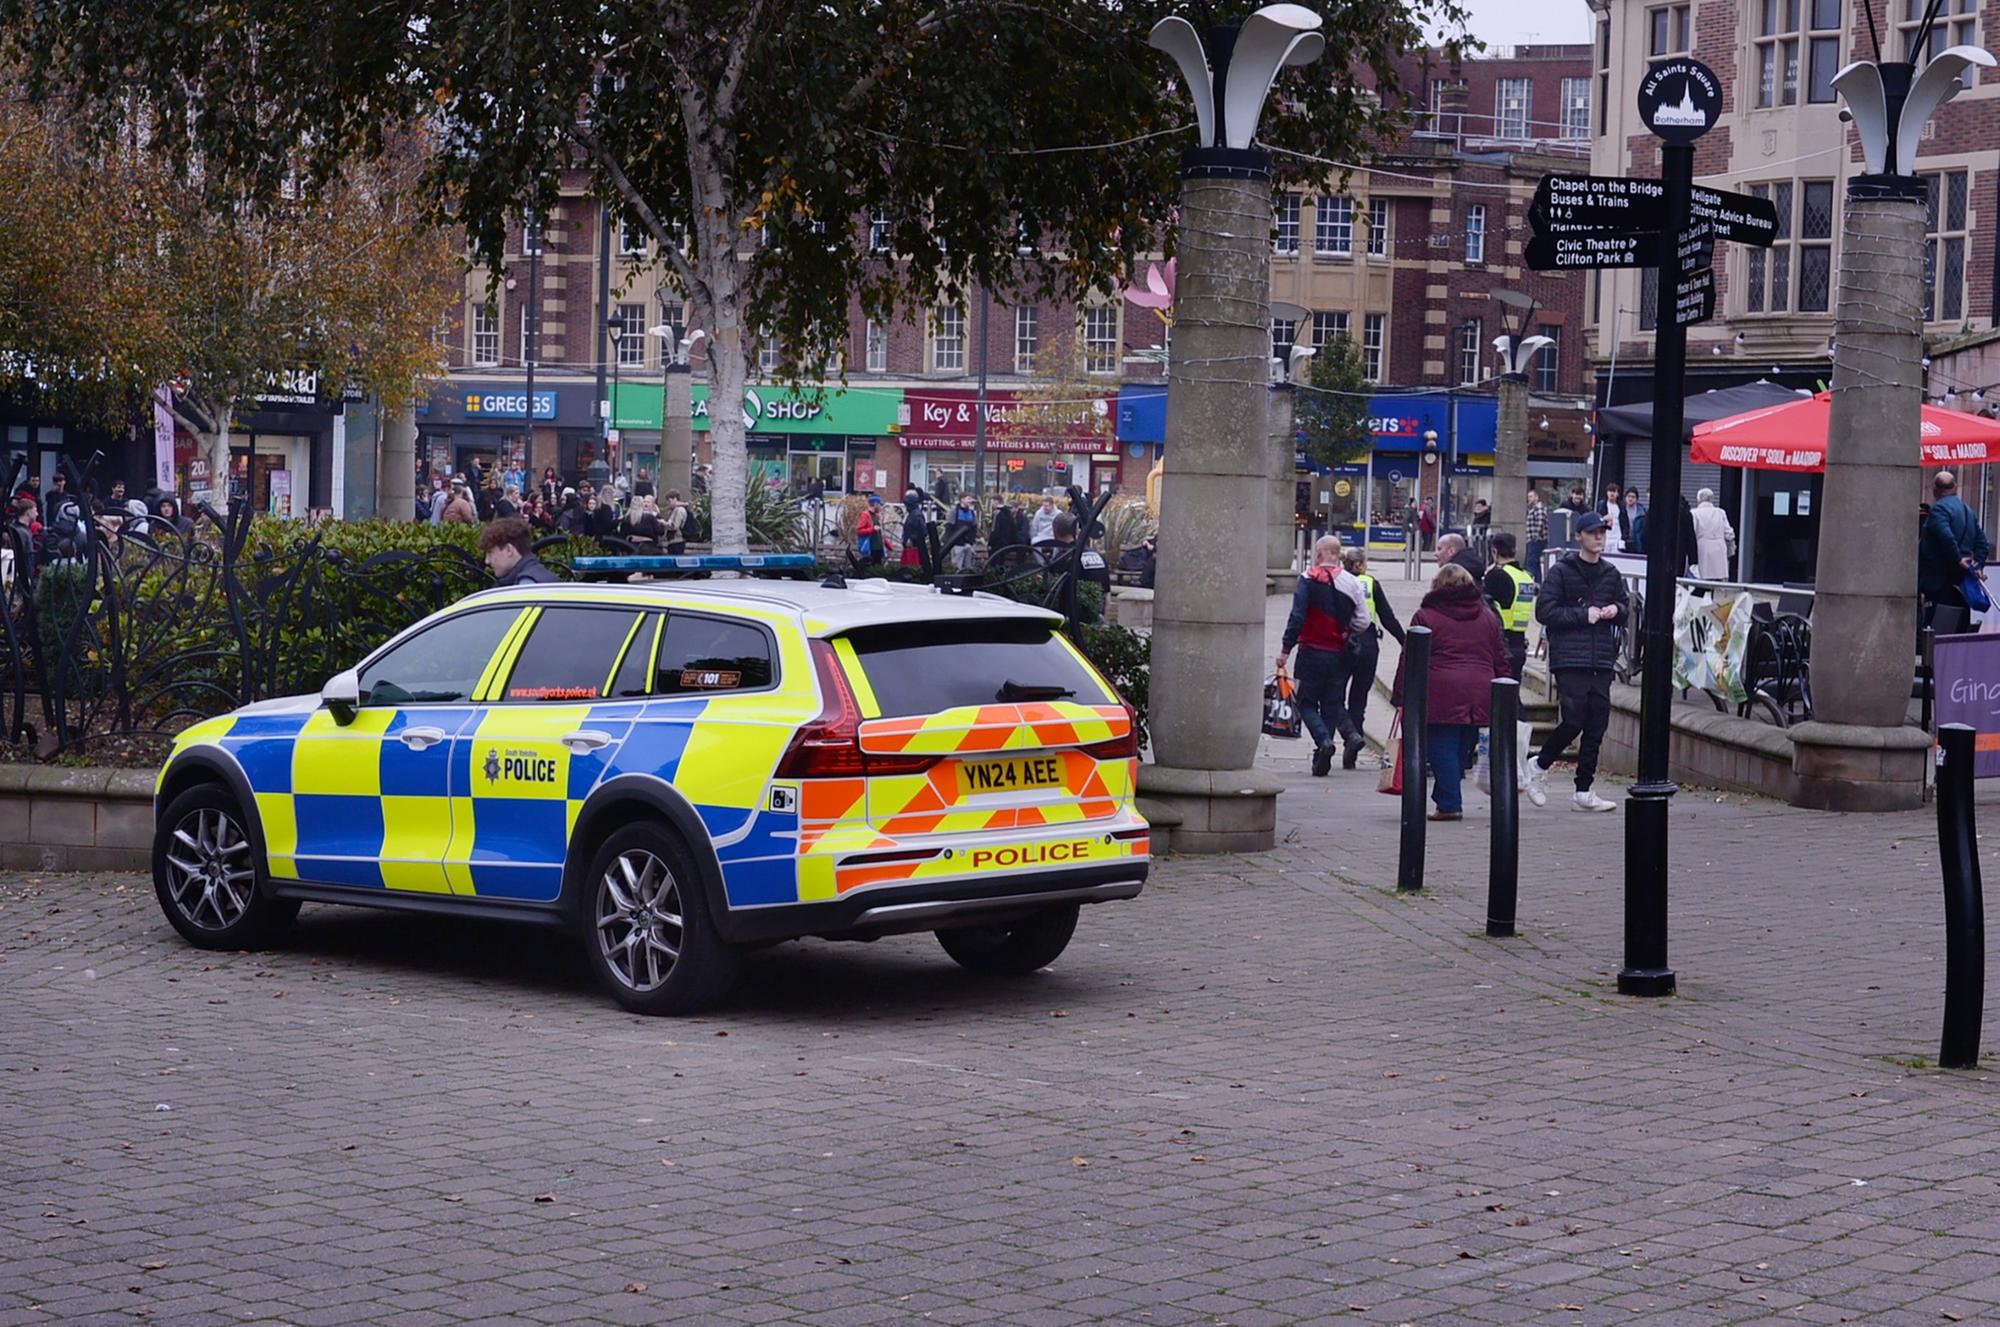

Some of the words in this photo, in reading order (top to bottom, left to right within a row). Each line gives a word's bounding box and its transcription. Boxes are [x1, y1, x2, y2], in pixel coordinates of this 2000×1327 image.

[1645, 80, 1658, 96] All
[1655, 64, 1686, 81] Saints
[1689, 66, 1715, 97] Square
[1655, 116, 1704, 124] Rotherham
[1550, 178, 1588, 193] Chapel
[1592, 183, 1605, 192] on
[1609, 181, 1626, 193] the
[1630, 182, 1663, 198] Bridge
[1551, 193, 1583, 206] Buses
[1586, 194, 1594, 206] &
[1597, 194, 1629, 208] Trains
[1712, 220, 1731, 236] treet
[1719, 208, 1744, 224] Advice
[1746, 213, 1773, 230] Bureau
[1556, 239, 1582, 252] Civic
[1586, 238, 1626, 250] Theatre
[1556, 252, 1593, 265] Clifton
[1597, 251, 1621, 264] Park
[483, 395, 551, 413] GREGGS
[766, 401, 820, 419] SHOP
[923, 402, 952, 428] Key
[956, 403, 970, 422] &
[910, 439, 922, 447] KEY
[923, 439, 956, 448] CUTTING
[960, 440, 977, 448] WAT
[987, 440, 1023, 449] BATTERIES
[1063, 442, 1103, 451] JEWELLERY
[1931, 444, 1951, 460] SOUL
[1956, 442, 1987, 458] MADRID
[1720, 445, 1758, 463] DISCOVER
[1766, 448, 1785, 465] SOUL
[1791, 450, 1822, 466] MADRID
[191, 460, 205, 476] 20
[703, 673, 720, 685] 101
[504, 758, 556, 782] POLICE
[964, 762, 1017, 790] YN24
[1024, 758, 1060, 785] AEE
[972, 841, 1090, 868] POLICE
